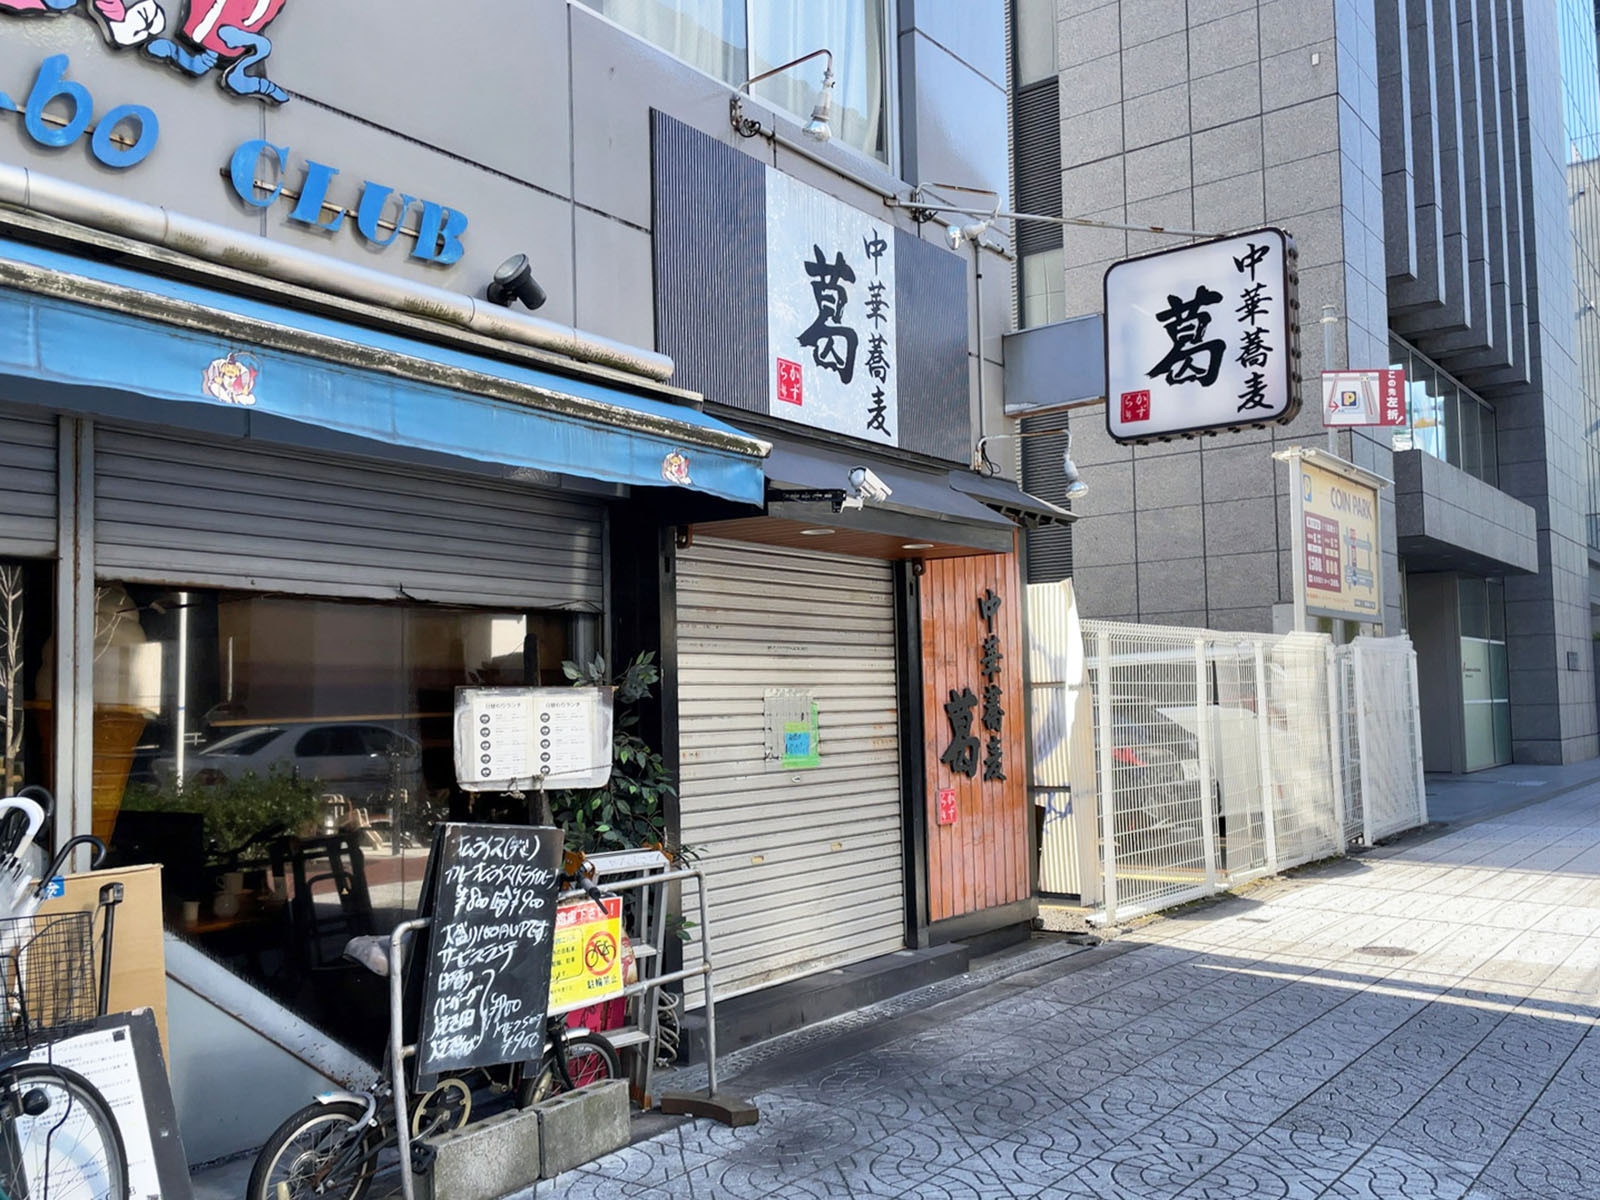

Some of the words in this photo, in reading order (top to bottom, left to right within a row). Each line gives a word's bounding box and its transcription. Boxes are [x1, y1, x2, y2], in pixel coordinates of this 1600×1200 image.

[0, 53, 159, 167] bo
[229, 139, 468, 264] CLUB
[796, 243, 859, 384] 葛
[862, 228, 891, 437] 中華蕎麦
[1145, 285, 1227, 387] 葛
[1232, 243, 1274, 413] 中華蕎麦
[1330, 487, 1351, 512] COIN
[1352, 495, 1372, 520] PARK
[977, 588, 1006, 782] 中華蕎麦
